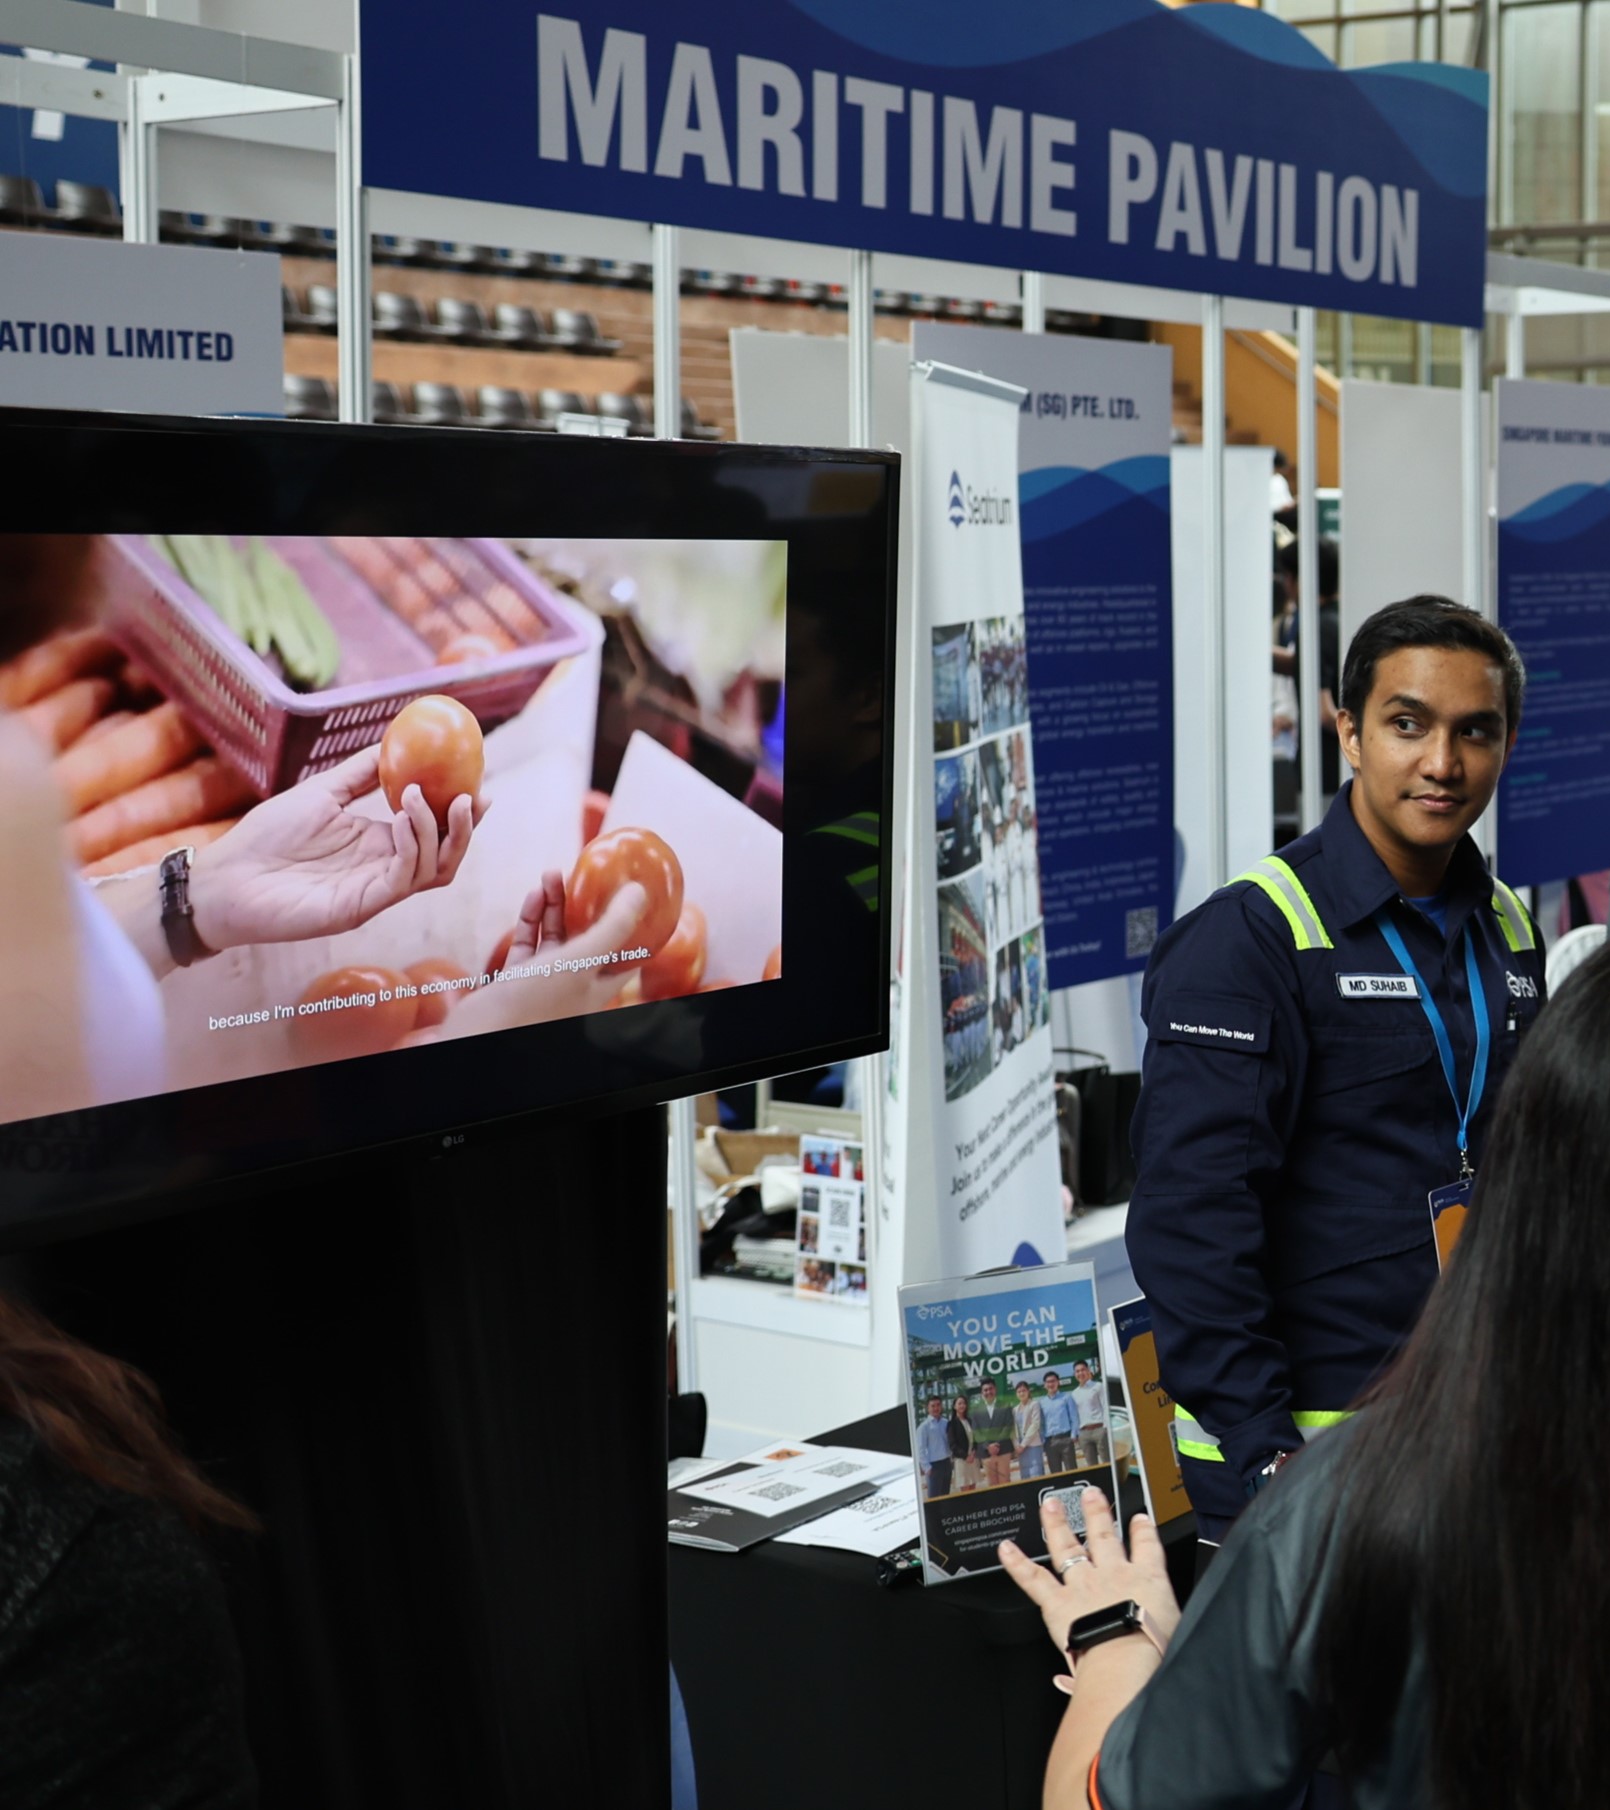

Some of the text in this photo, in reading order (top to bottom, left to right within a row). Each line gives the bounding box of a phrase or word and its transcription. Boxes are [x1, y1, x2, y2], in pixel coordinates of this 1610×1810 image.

[537, 13, 1419, 289] MARITIME PAVILION
[0, 320, 235, 362] ATION LIMITED
[1037, 393, 1067, 420] (SG)
[1072, 394, 1104, 418] PTE.
[1109, 396, 1141, 419] LTD.
[209, 946, 651, 1030] because I'm contributing to this economy in facilitating Singapore's trade.
[1348, 980, 1408, 992] MD SUHAIB
[1170, 1022, 1254, 1042] You Can Move The World
[453, 1134, 465, 1145] LG
[930, 1305, 953, 1319] PSA
[947, 1304, 1057, 1338] YOU CAN
[943, 1324, 1066, 1362] MOVE THE
[963, 1349, 1049, 1377] WORLD
[941, 1502, 1026, 1526] SCAN HERE FOR PSA
[945, 1512, 1027, 1536] CAREER BROCHURE
